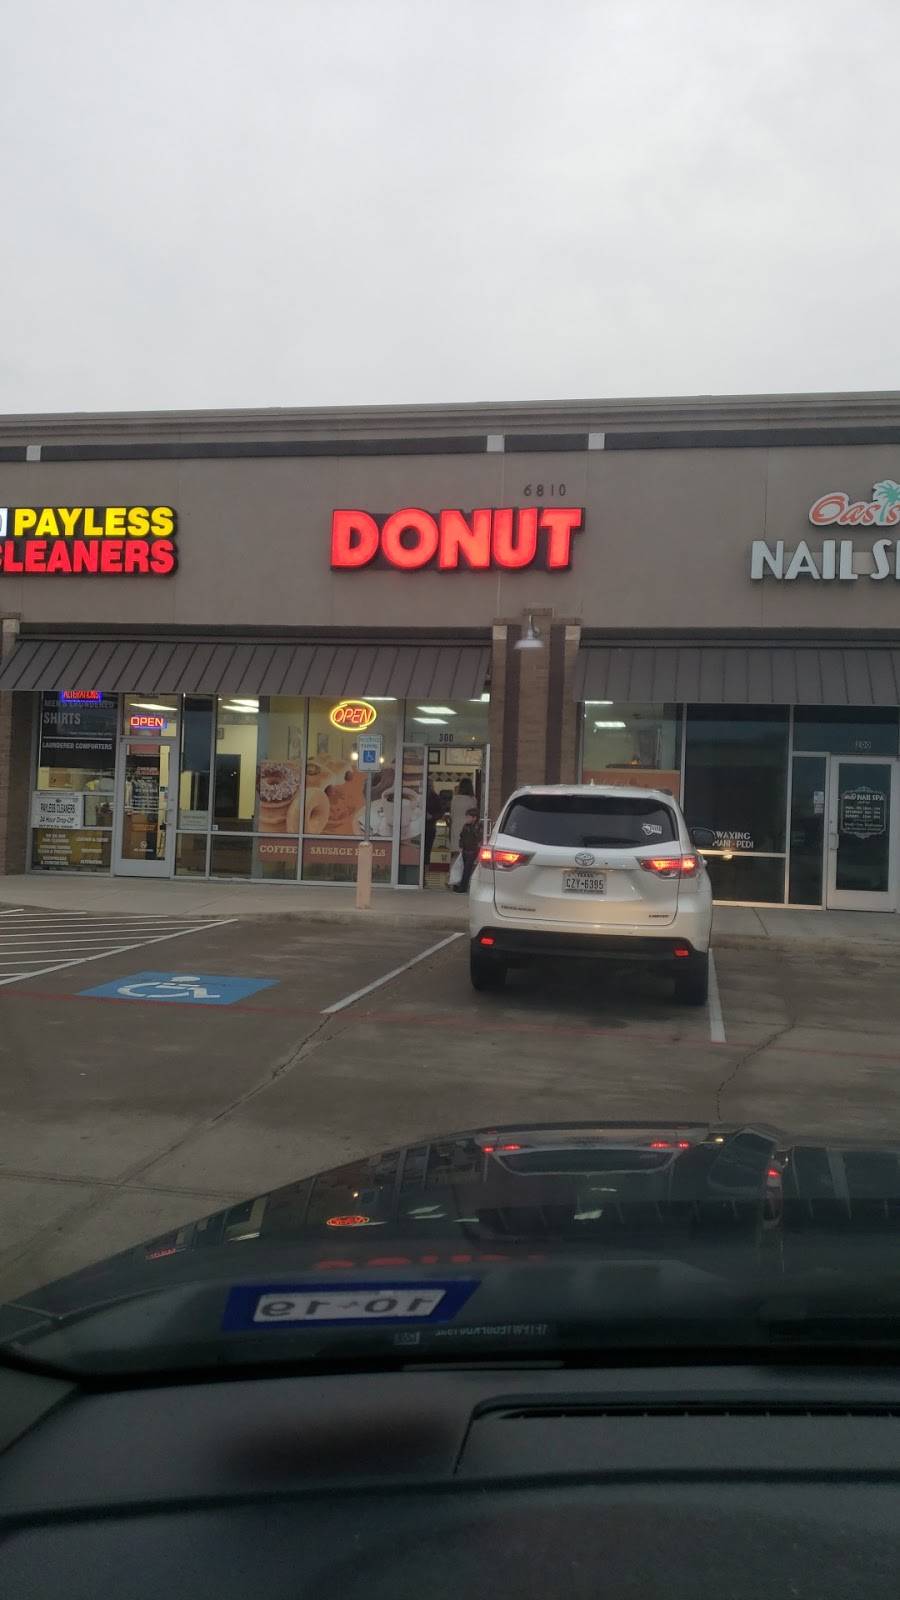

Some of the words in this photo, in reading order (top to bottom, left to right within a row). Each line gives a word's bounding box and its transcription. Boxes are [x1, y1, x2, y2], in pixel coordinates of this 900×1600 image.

[522, 483, 567, 497] 6810
[14, 506, 175, 537] PAYLESS
[331, 507, 584, 570] DONUT
[0, 539, 175, 574] LEANERS
[751, 539, 858, 581] NAIL
[870, 538, 900, 581] S
[43, 712, 81, 725] SHIRTS
[130, 716, 164, 728] OPEN
[334, 707, 373, 725] OPEN
[715, 830, 751, 840] WAXING
[259, 844, 299, 854] COFFEE
[736, 840, 754, 848] PEDI
[310, 846, 354, 856] SAUSAGE
